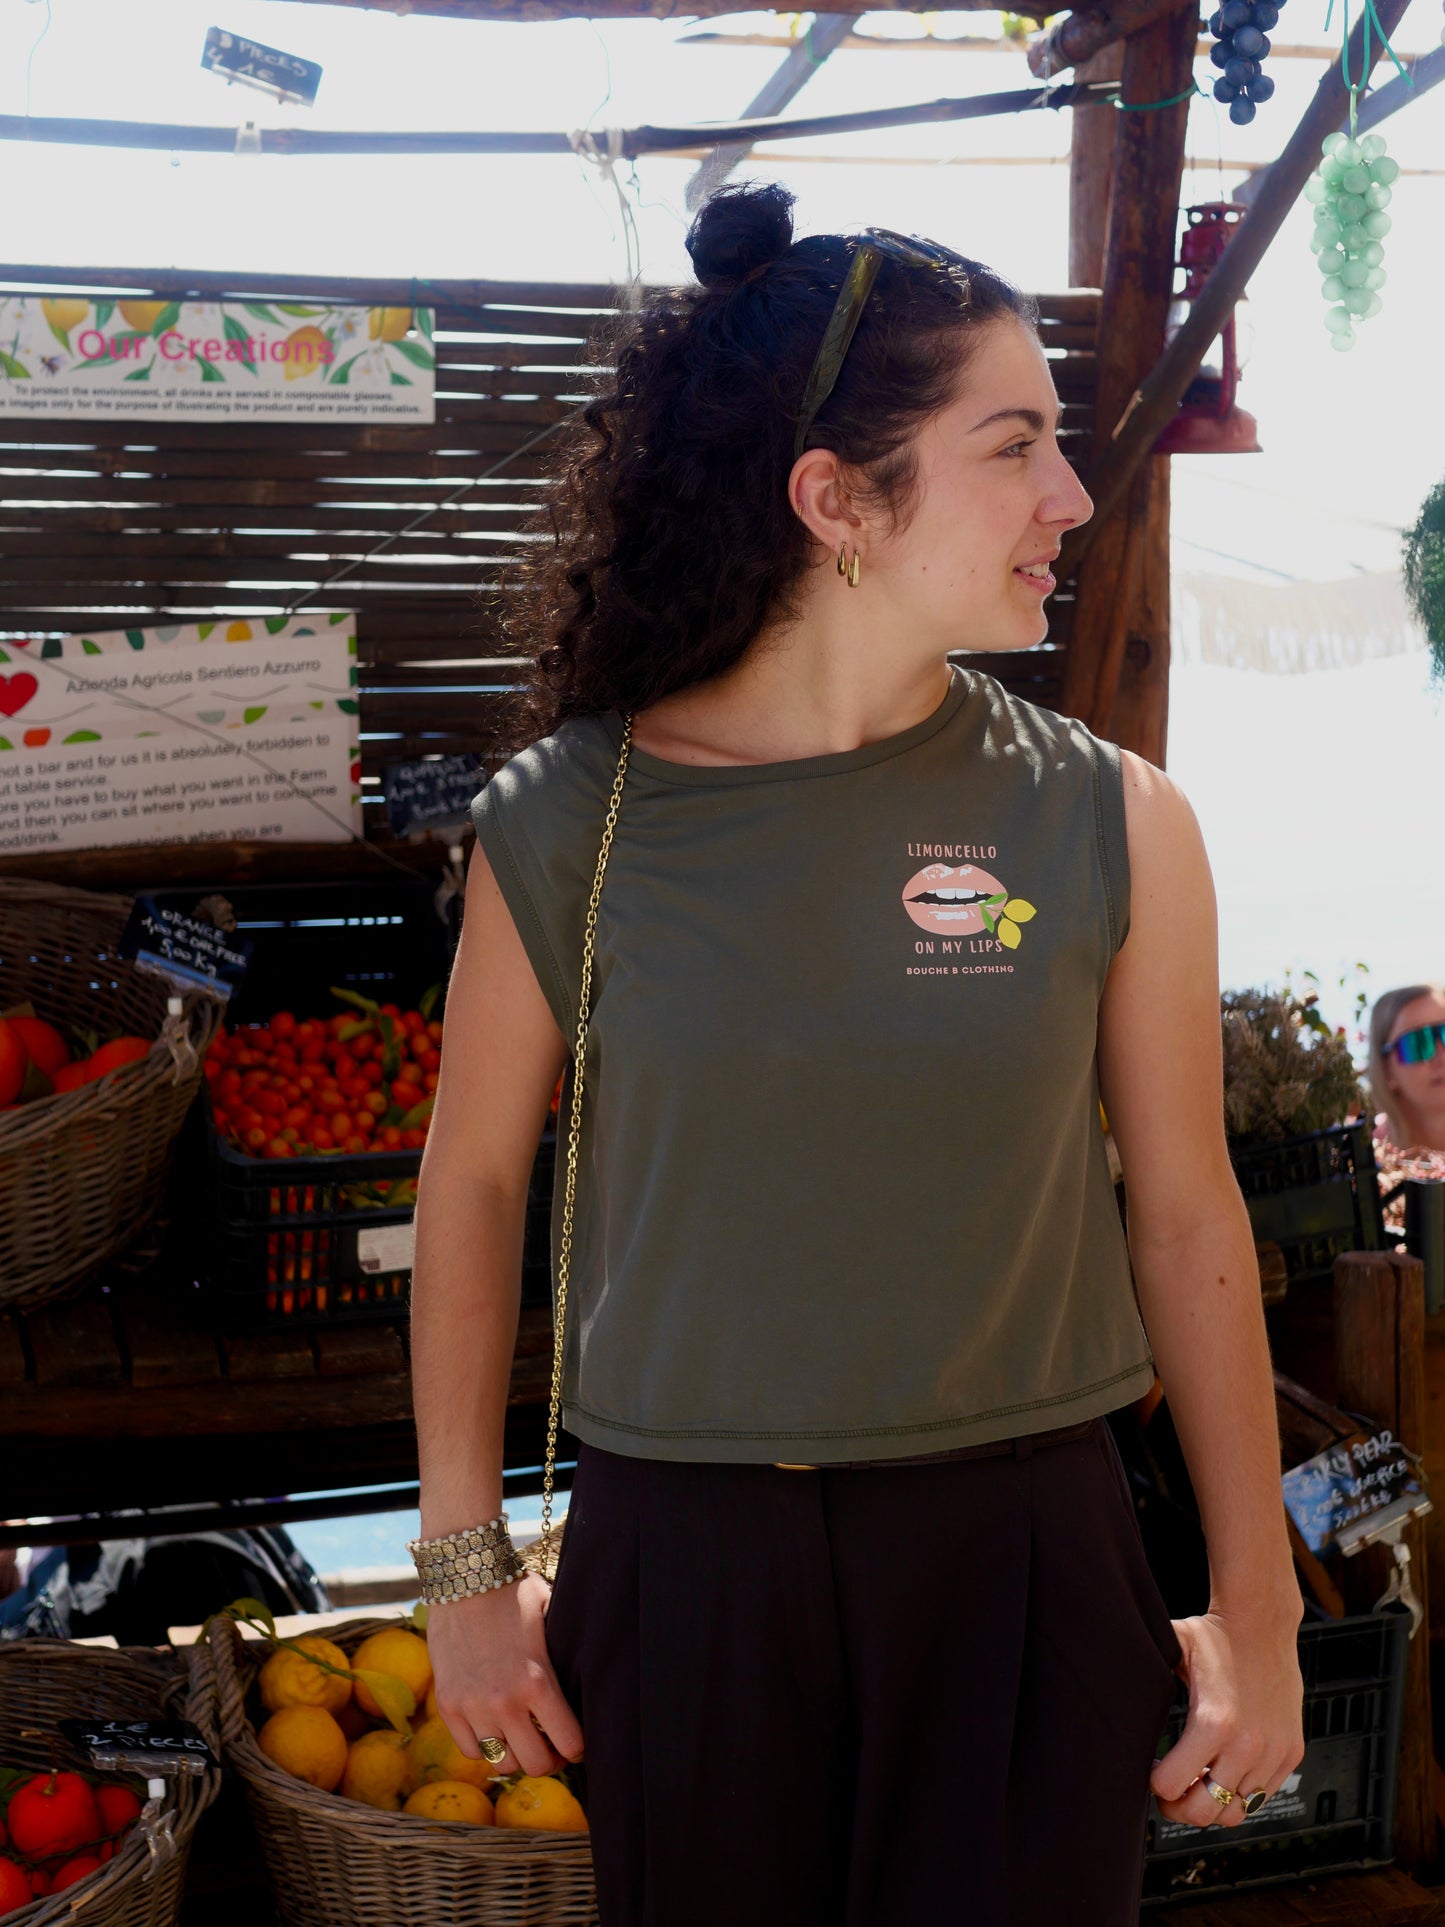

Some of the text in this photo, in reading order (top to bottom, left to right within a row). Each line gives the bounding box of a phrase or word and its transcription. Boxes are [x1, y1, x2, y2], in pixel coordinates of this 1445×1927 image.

[78, 330, 335, 365] Our Creations
[16, 385, 28, 395] To
[31, 386, 69, 397] protect
[72, 387, 88, 396] the
[92, 387, 161, 398] environment,
[164, 388, 176, 397] all
[181, 388, 212, 398] drinks
[216, 390, 232, 398] are
[236, 389, 270, 399] served
[274, 390, 282, 399] in
[285, 390, 350, 401] compostable
[9, 399, 47, 410] images
[51, 400, 73, 410] only
[77, 400, 91, 408] for
[95, 400, 111, 409] the
[114, 401, 158, 411] purpose
[162, 401, 173, 410] of
[175, 402, 231, 412] illustrating
[234, 403, 248, 411] the
[252, 403, 294, 413] product
[297, 403, 315, 412] and
[336, 404, 368, 414] purely
[66, 658, 321, 694] Azienda Agricola Sentiero Azzurro
[25, 766, 33, 775] a
[38, 761, 61, 773] bar
[67, 757, 93, 770] and
[98, 755, 116, 767] for
[121, 755, 138, 765] us
[143, 751, 151, 762] it
[156, 750, 166, 761] is
[171, 742, 242, 759] absolutely
[246, 735, 313, 752] forbidden
[316, 734, 330, 746] to
[15, 777, 50, 793] table
[24, 797, 50, 813] you
[54, 793, 90, 808] have
[94, 790, 108, 803] to
[112, 787, 137, 802] buy
[142, 783, 176, 797] what
[180, 780, 206, 795] you
[210, 775, 243, 790] want
[248, 772, 260, 785] in
[264, 770, 286, 784] the
[290, 767, 327, 781] Farm
[24, 812, 56, 829] then
[60, 810, 87, 827] you
[91, 807, 117, 822] can
[122, 803, 137, 817] sit
[142, 799, 185, 815] where
[190, 796, 215, 812] you
[219, 791, 252, 806] want
[256, 789, 270, 802] to
[274, 784, 337, 801] consume
[190, 827, 227, 844] when
[231, 826, 256, 841] you
[260, 823, 283, 836] are
[908, 843, 997, 859] LIMONCELLO
[915, 939, 1003, 954] ON MY LIPS
[906, 965, 1014, 975] BOUCHE B CLOTHING
[1352, 1430, 1397, 1468] PEAR
[82, 1734, 112, 1746] 2
